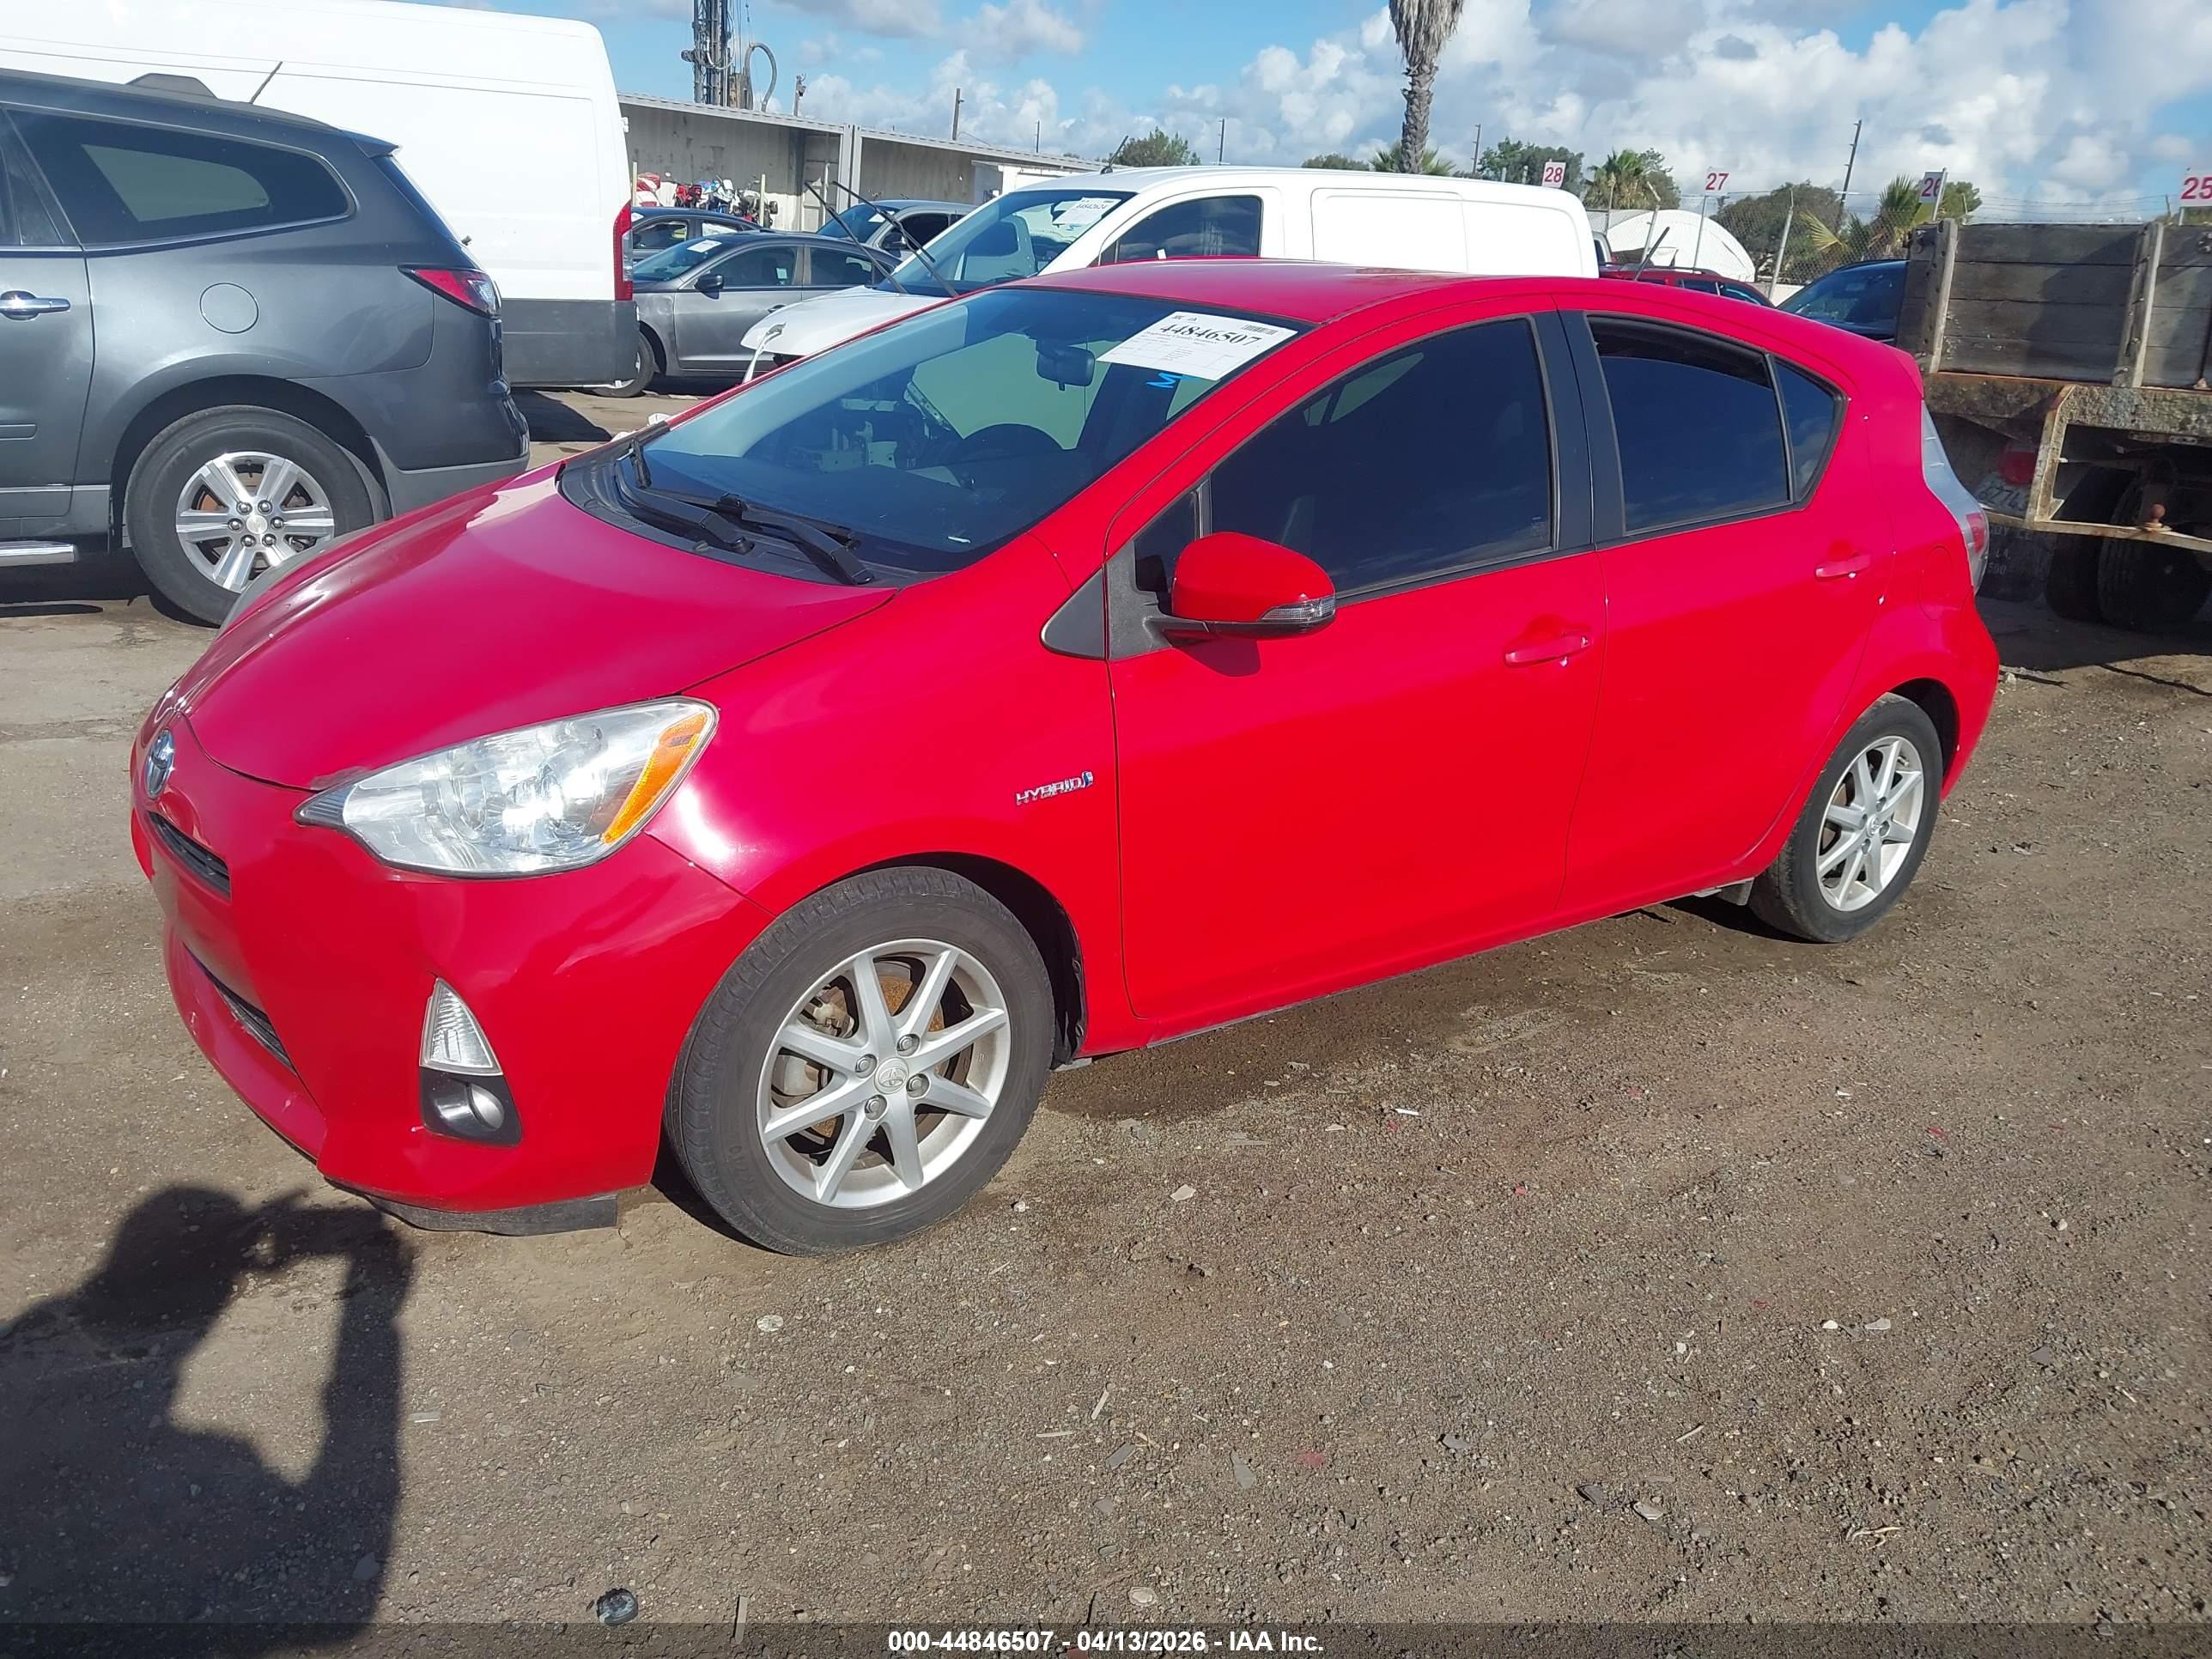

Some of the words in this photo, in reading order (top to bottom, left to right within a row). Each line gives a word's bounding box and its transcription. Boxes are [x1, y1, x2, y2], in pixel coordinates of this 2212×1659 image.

[1544, 167, 1563, 183] 28
[1705, 173, 1729, 190] 27
[2180, 177, 2212, 199] 25
[1159, 324, 1262, 345] 44846507
[1016, 776, 1083, 805] HYBRID
